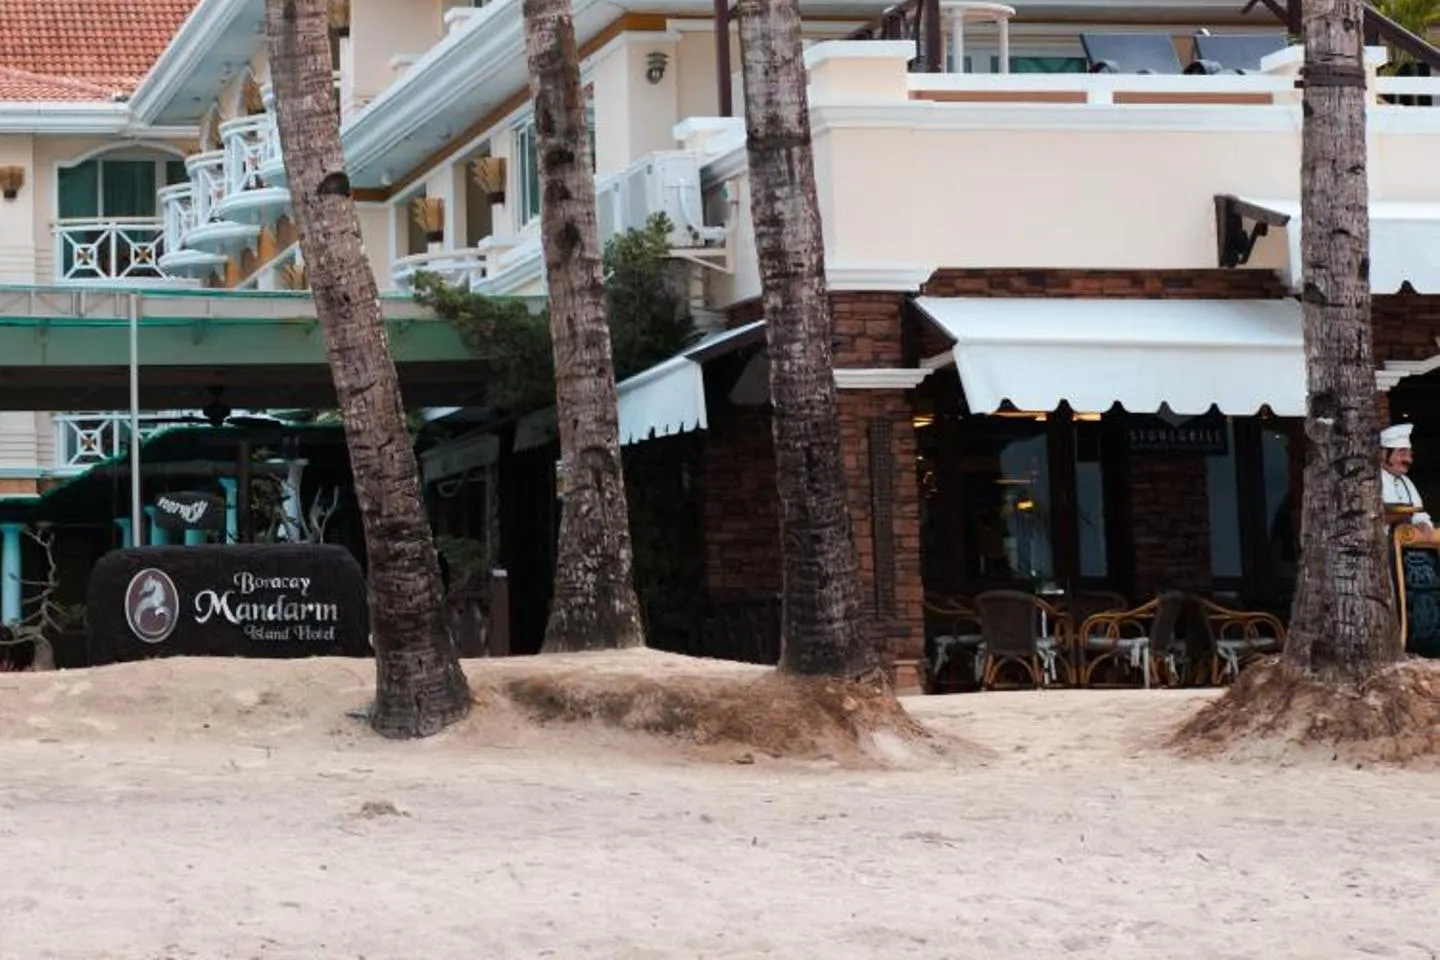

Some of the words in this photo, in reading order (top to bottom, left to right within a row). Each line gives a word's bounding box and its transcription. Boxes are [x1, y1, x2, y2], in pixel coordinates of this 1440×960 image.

[233, 571, 311, 596] Boracay
[194, 589, 338, 624] Mandarin
[244, 624, 290, 640] Island
[294, 624, 335, 640] Hotel
